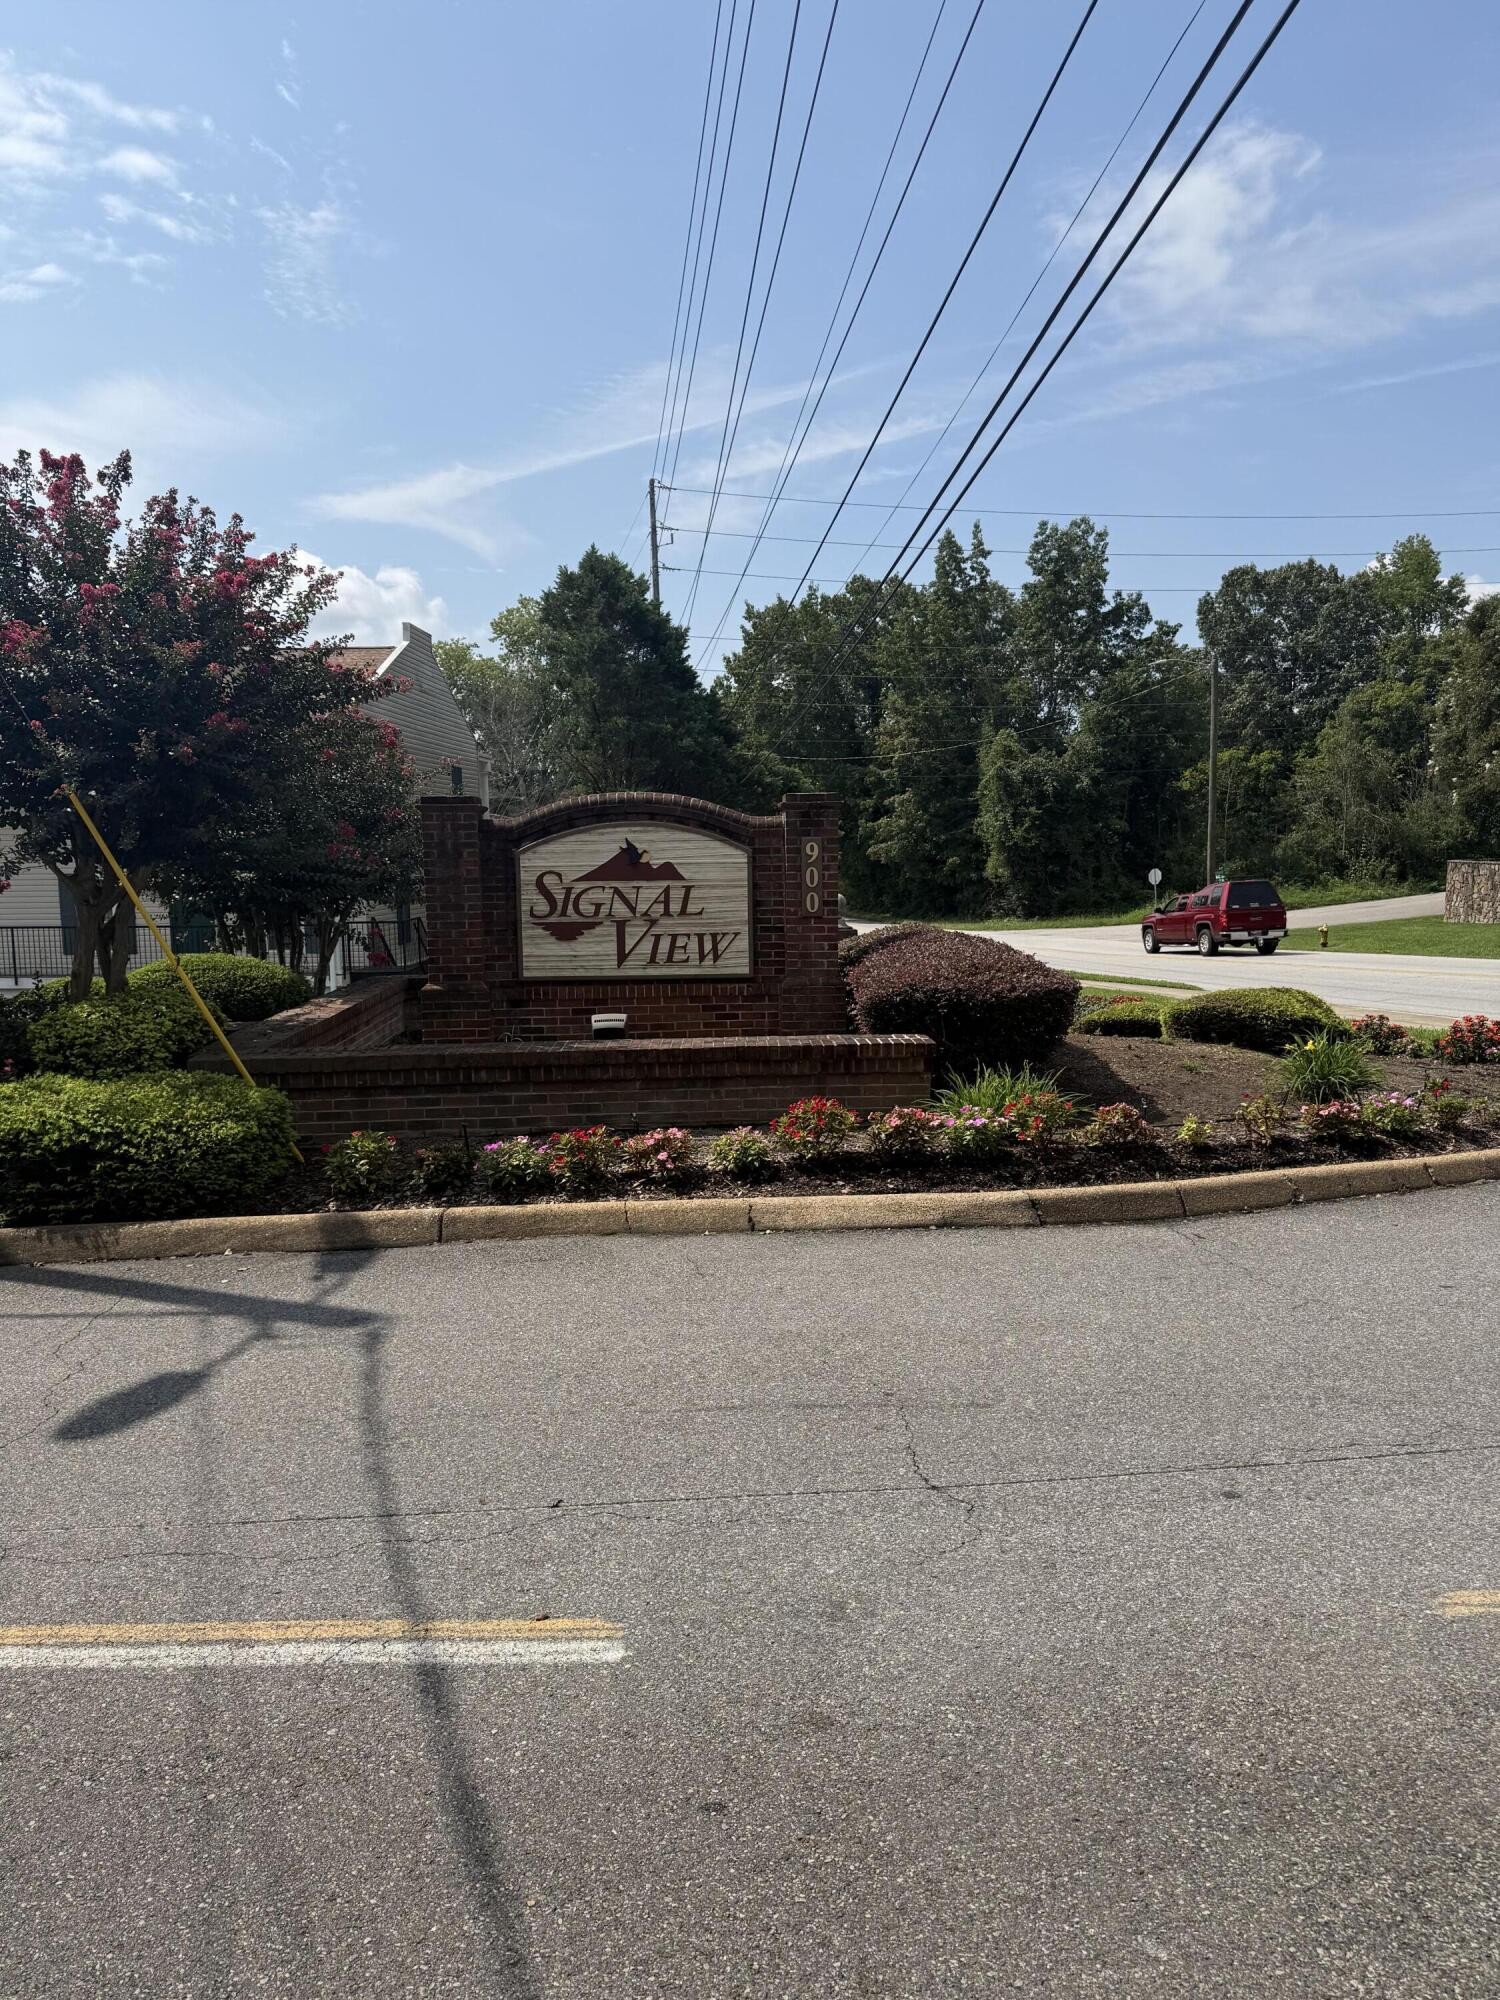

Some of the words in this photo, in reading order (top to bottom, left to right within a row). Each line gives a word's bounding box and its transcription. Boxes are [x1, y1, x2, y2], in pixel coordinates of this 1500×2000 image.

[529, 870, 705, 919] SIGNAL
[805, 841, 820, 914] 900
[610, 919, 741, 968] VIEW
